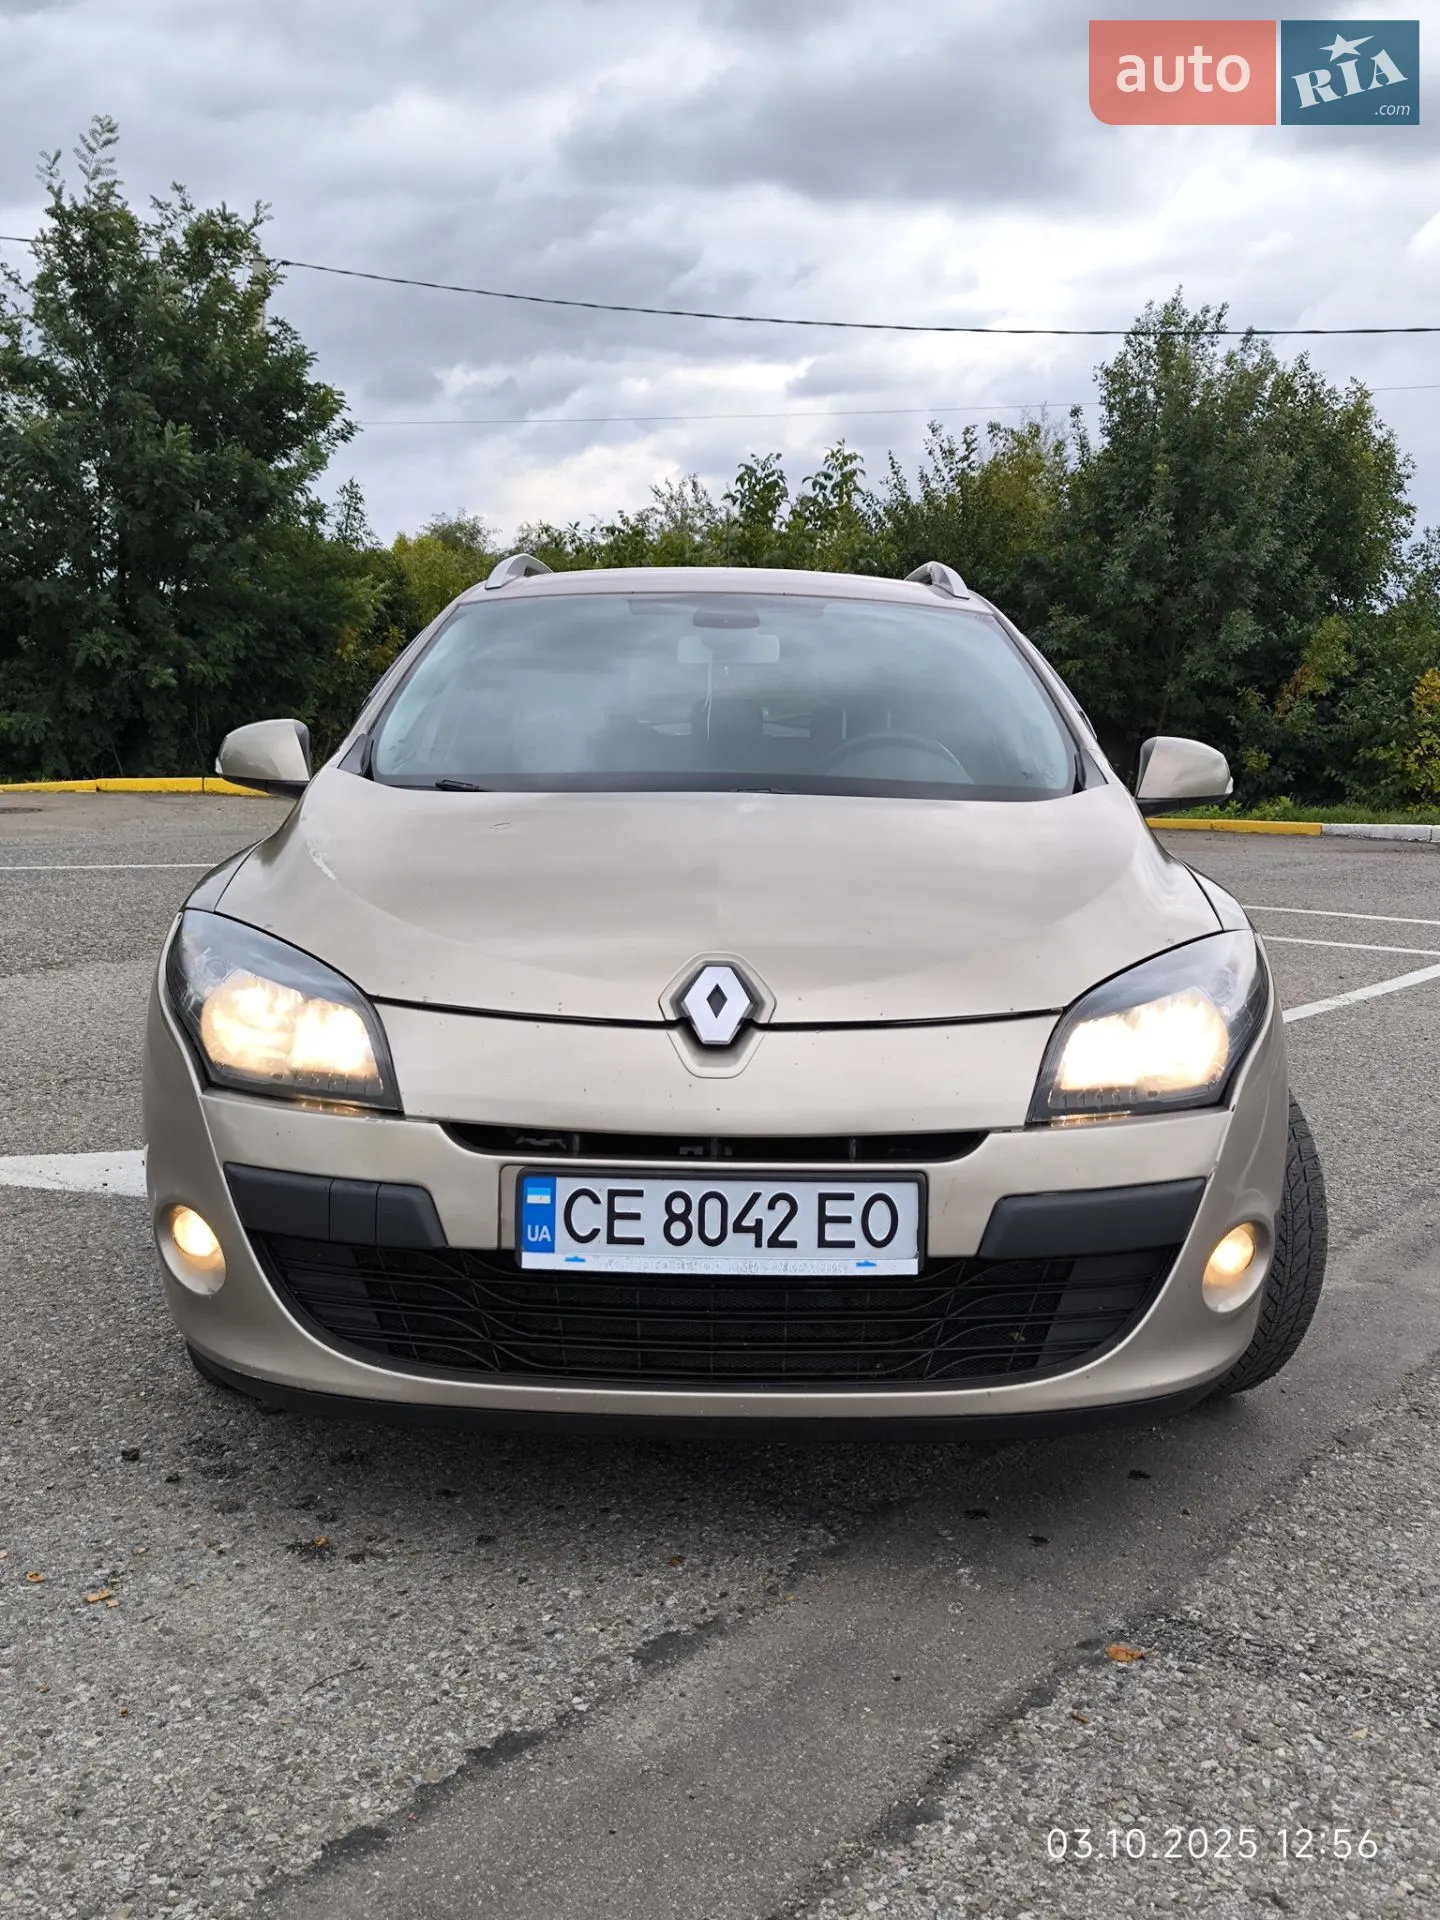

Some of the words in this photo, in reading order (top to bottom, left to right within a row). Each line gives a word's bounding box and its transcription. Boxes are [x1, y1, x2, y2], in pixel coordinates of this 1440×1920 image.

[526, 1225, 552, 1243] UA
[563, 1187, 646, 1246] CE
[662, 1190, 799, 1249] 8042
[817, 1191, 900, 1249] EO
